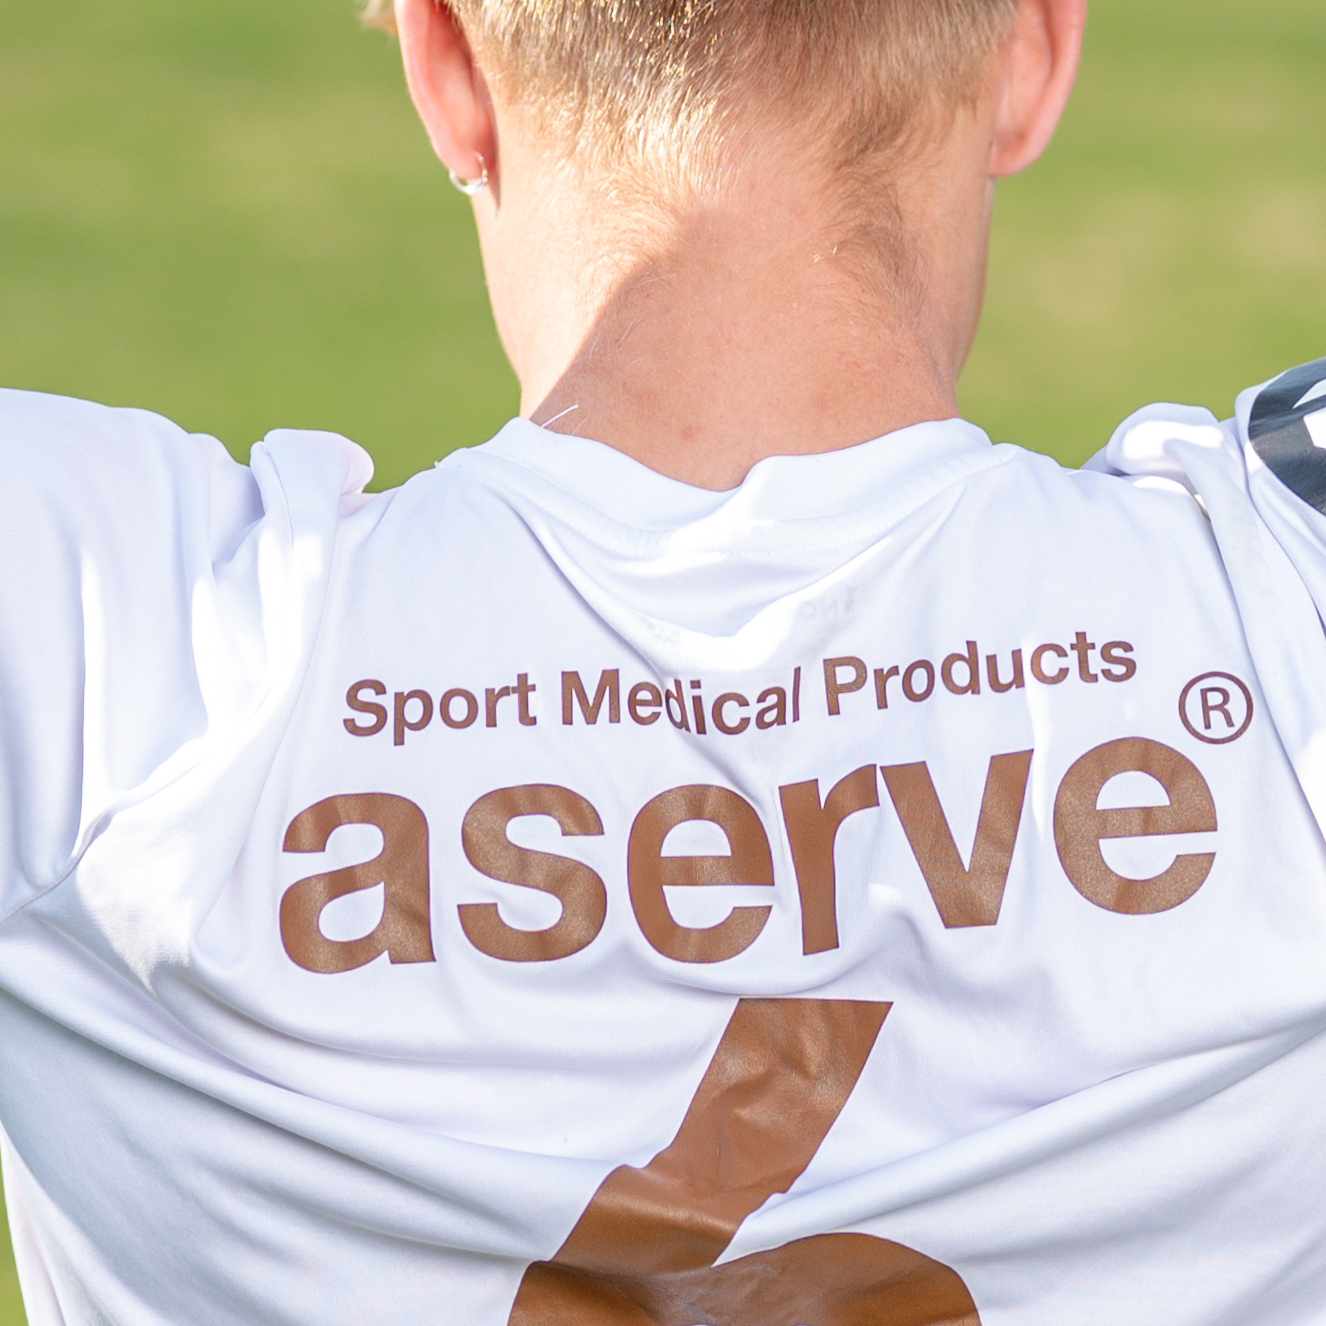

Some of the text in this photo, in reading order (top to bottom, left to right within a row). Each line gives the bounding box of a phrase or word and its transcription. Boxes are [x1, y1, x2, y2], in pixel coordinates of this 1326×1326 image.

[343, 631, 1138, 746] Sport Medical Products
